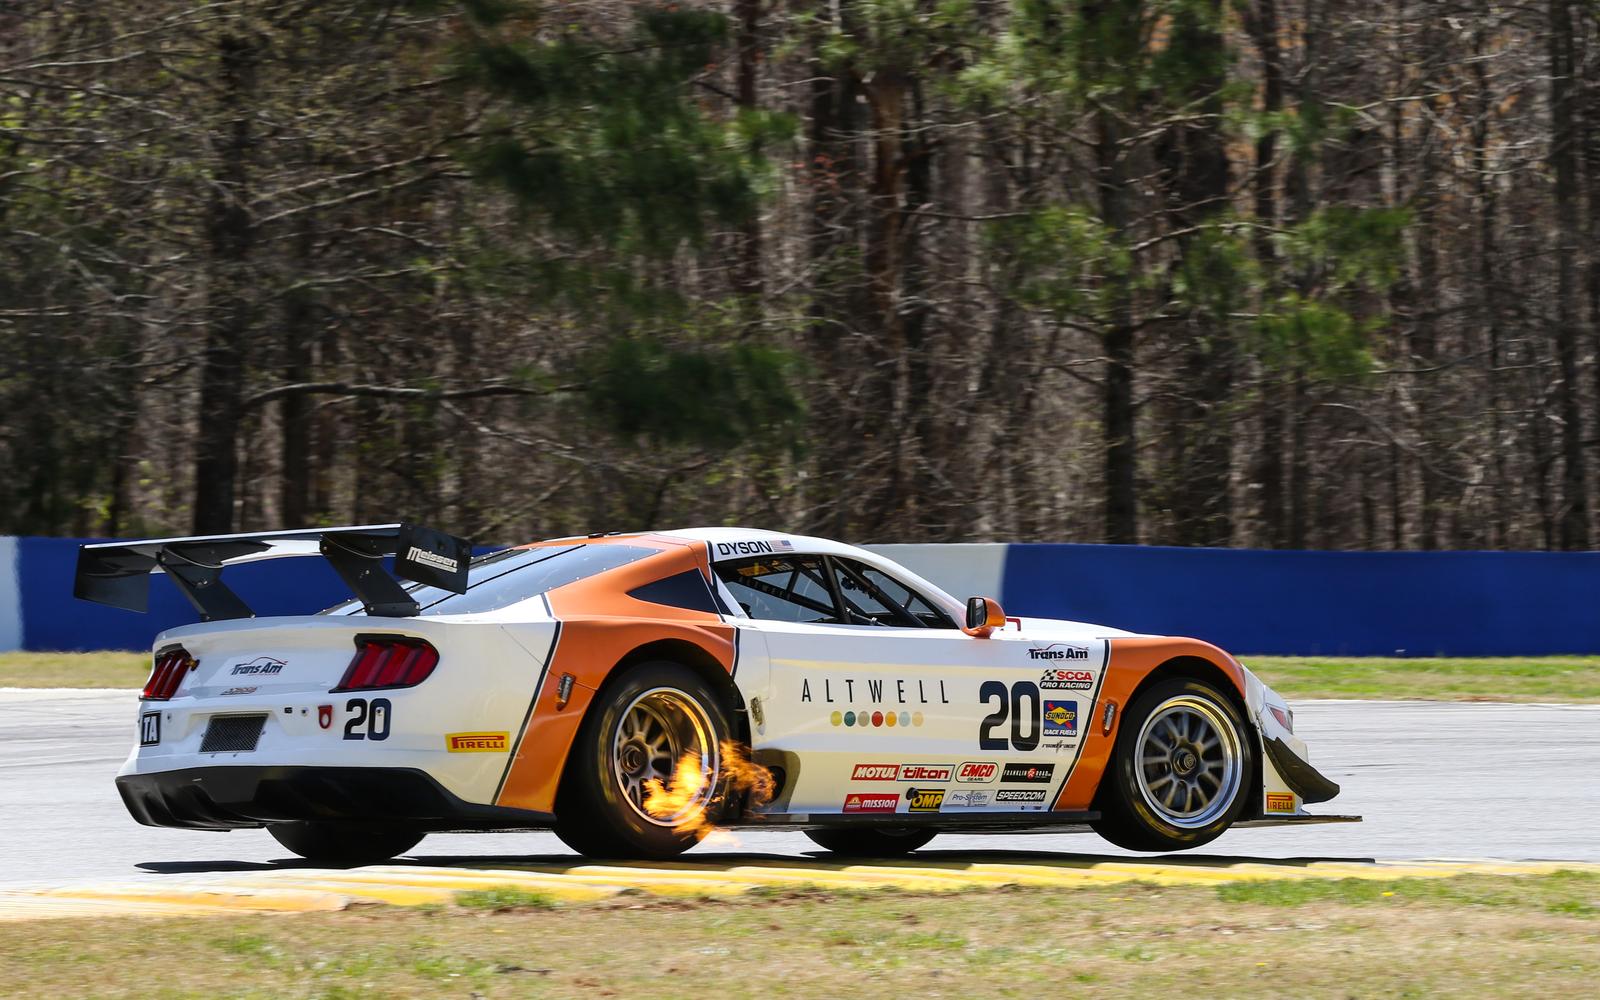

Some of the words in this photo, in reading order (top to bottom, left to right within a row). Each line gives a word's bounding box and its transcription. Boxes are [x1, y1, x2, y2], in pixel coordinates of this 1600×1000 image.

[717, 540, 773, 556] DYSON
[406, 546, 458, 568] Meissen
[1028, 648, 1064, 660] Trans
[1065, 648, 1088, 659] Am
[230, 664, 261, 676] Trans
[260, 662, 283, 674] Am
[1056, 671, 1093, 681] SCCA
[801, 677, 950, 704] ALTWELL
[1041, 681, 1057, 689] PRO
[1059, 681, 1091, 690] RACING
[342, 697, 392, 742] 20
[979, 680, 1041, 752] 20
[1045, 711, 1076, 721] SUNOCO
[143, 714, 159, 743] TA
[451, 734, 505, 749] PIRELLI
[853, 766, 897, 779] MOTUL
[902, 766, 950, 780] tilton
[960, 764, 995, 777] EMCO
[911, 793, 943, 808] OMP
[996, 791, 1045, 801] SPEEDCOM
[1266, 794, 1293, 810] PIRELLI
